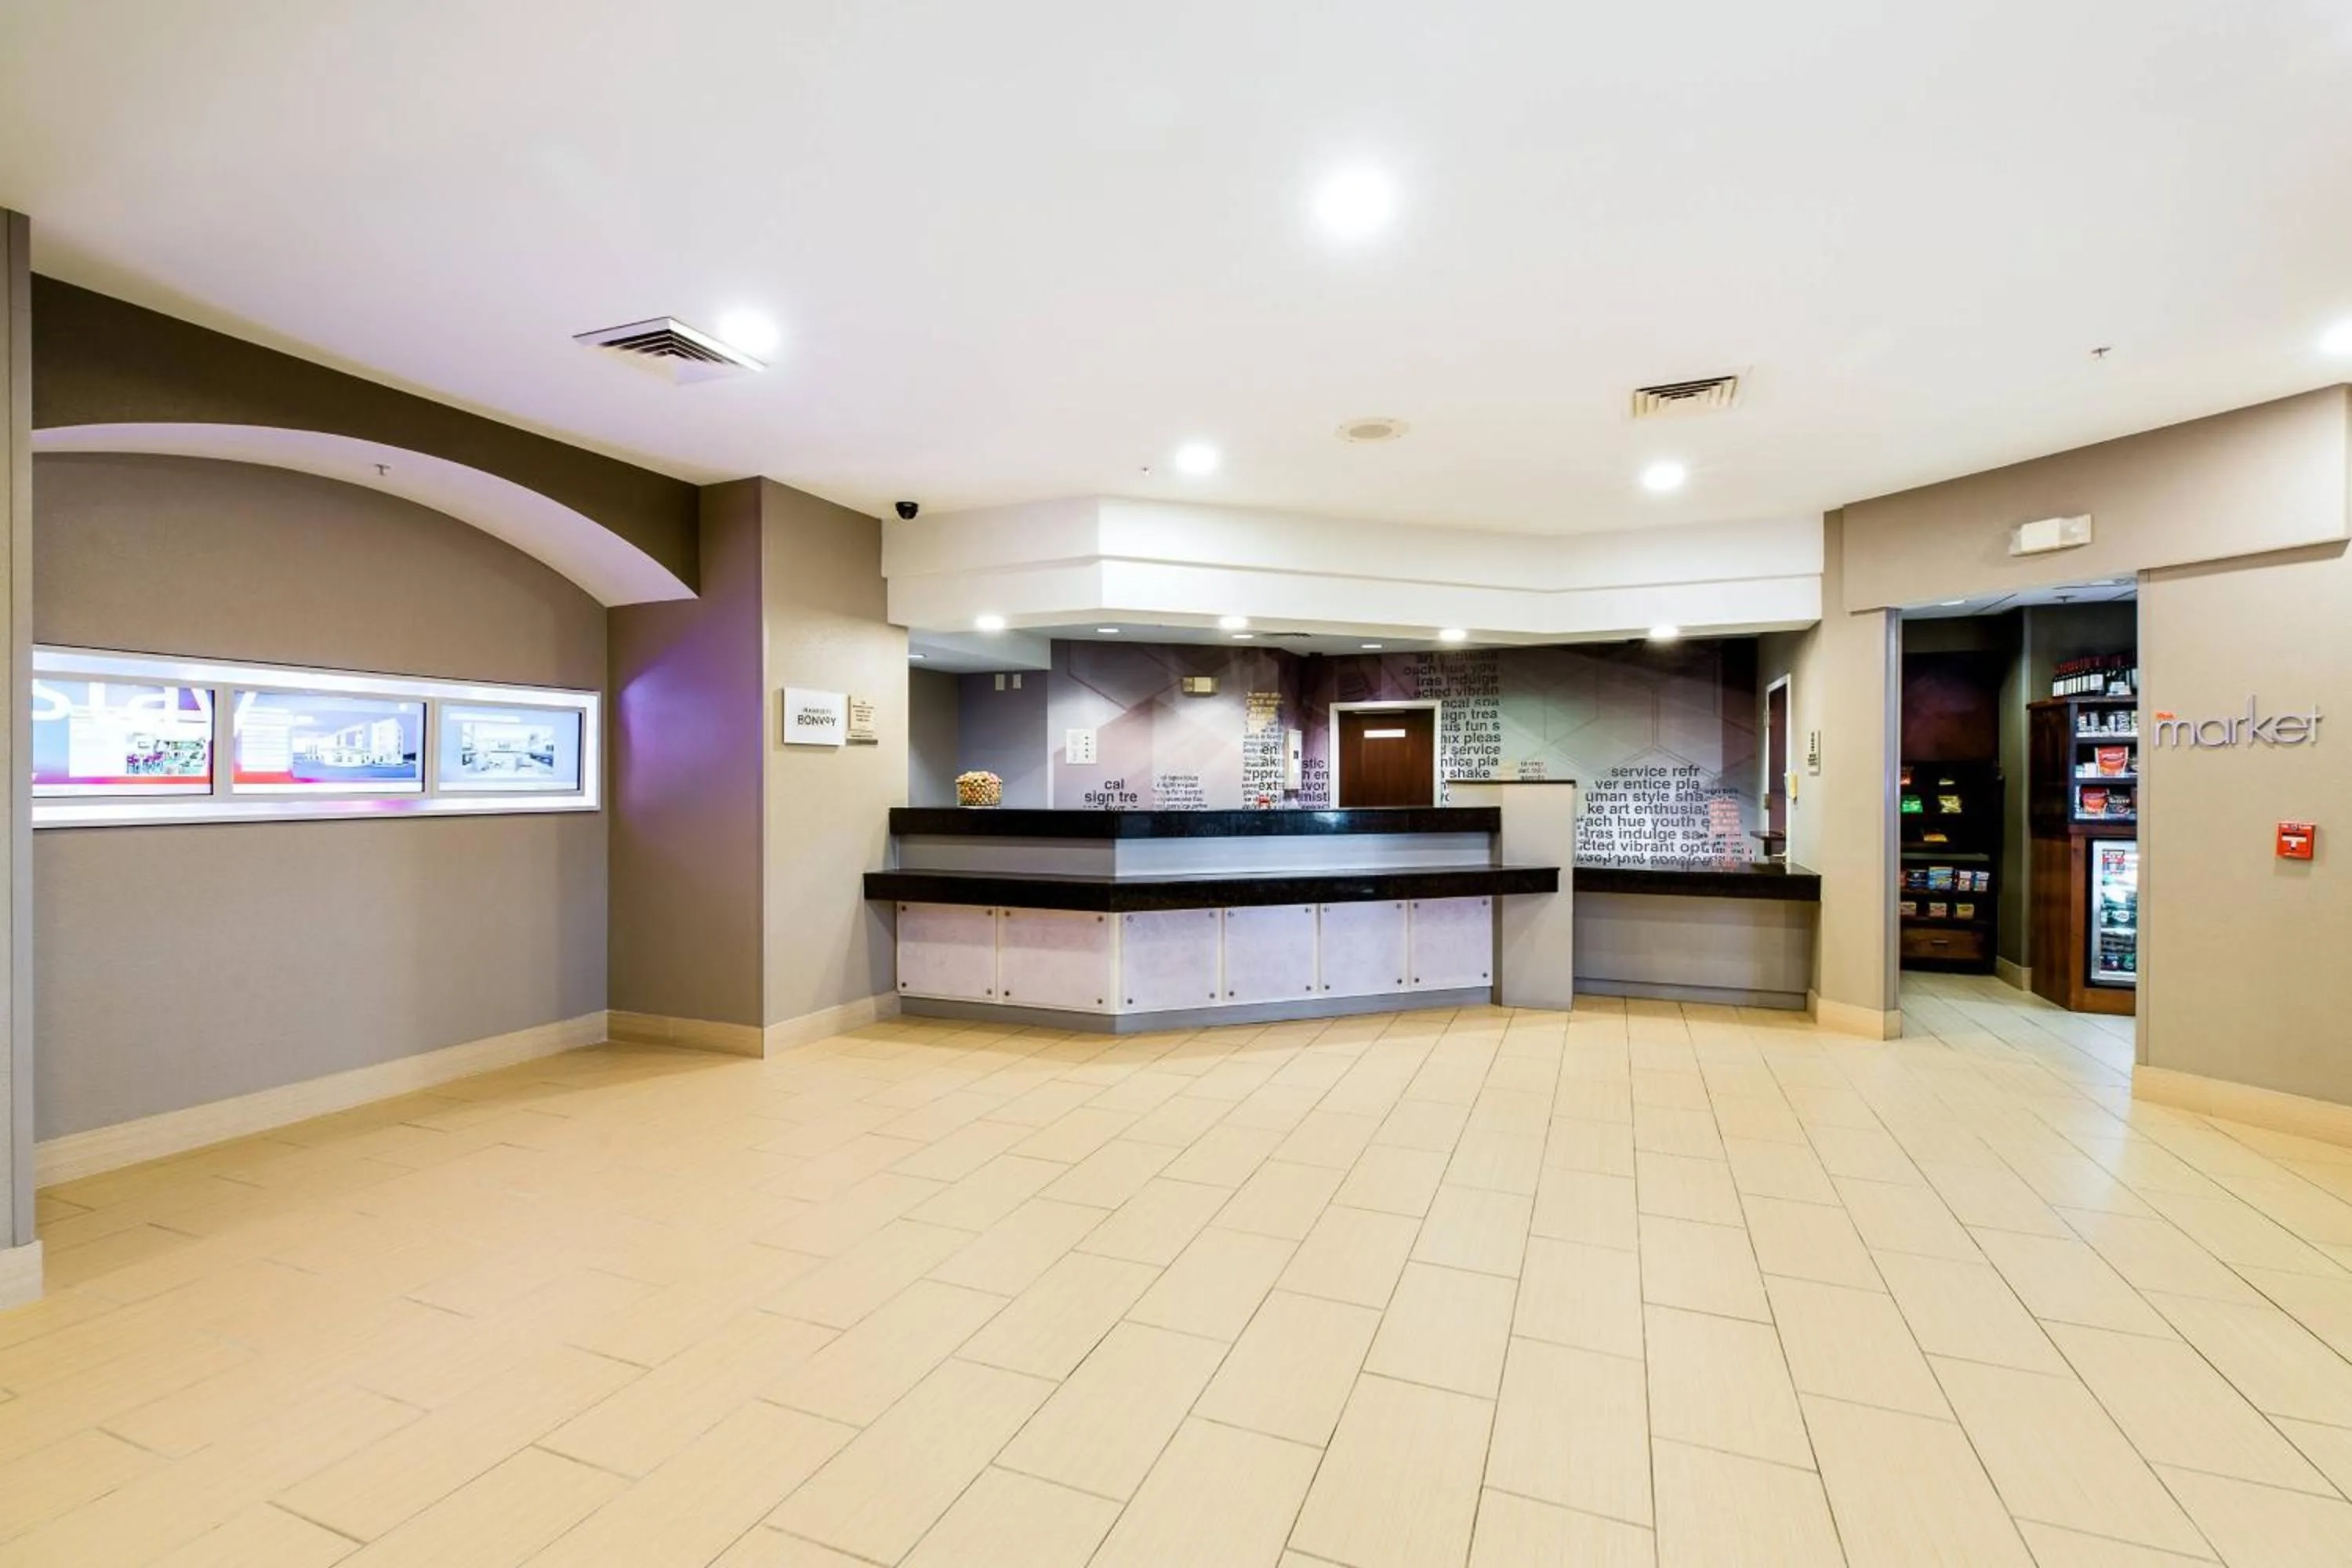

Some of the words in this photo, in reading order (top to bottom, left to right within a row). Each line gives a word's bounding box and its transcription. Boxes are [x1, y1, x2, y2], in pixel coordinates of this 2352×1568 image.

[797, 714, 837, 726] BONVOY
[2154, 693, 2324, 746] market
[1465, 733, 1501, 746] pleas
[1451, 743, 1501, 755] service
[1450, 768, 1490, 778] shake
[1611, 765, 1667, 777] service
[1672, 764, 1700, 777] refr
[1104, 779, 1125, 789] cal
[1595, 780, 1619, 789] ver
[1624, 778, 1671, 789] entice
[1676, 778, 1700, 791] pla
[1084, 790, 1114, 804] sign
[1119, 792, 1138, 803] tre
[1585, 793, 1627, 802] uman
[1633, 790, 1670, 804] style
[1588, 803, 1604, 814] ke
[1610, 804, 1629, 814] art
[1584, 815, 1612, 826] ach
[1618, 815, 1646, 826] hue
[1651, 815, 1695, 829] youth
[1619, 828, 1676, 842] indulge
[1621, 840, 1675, 851] vibrant
